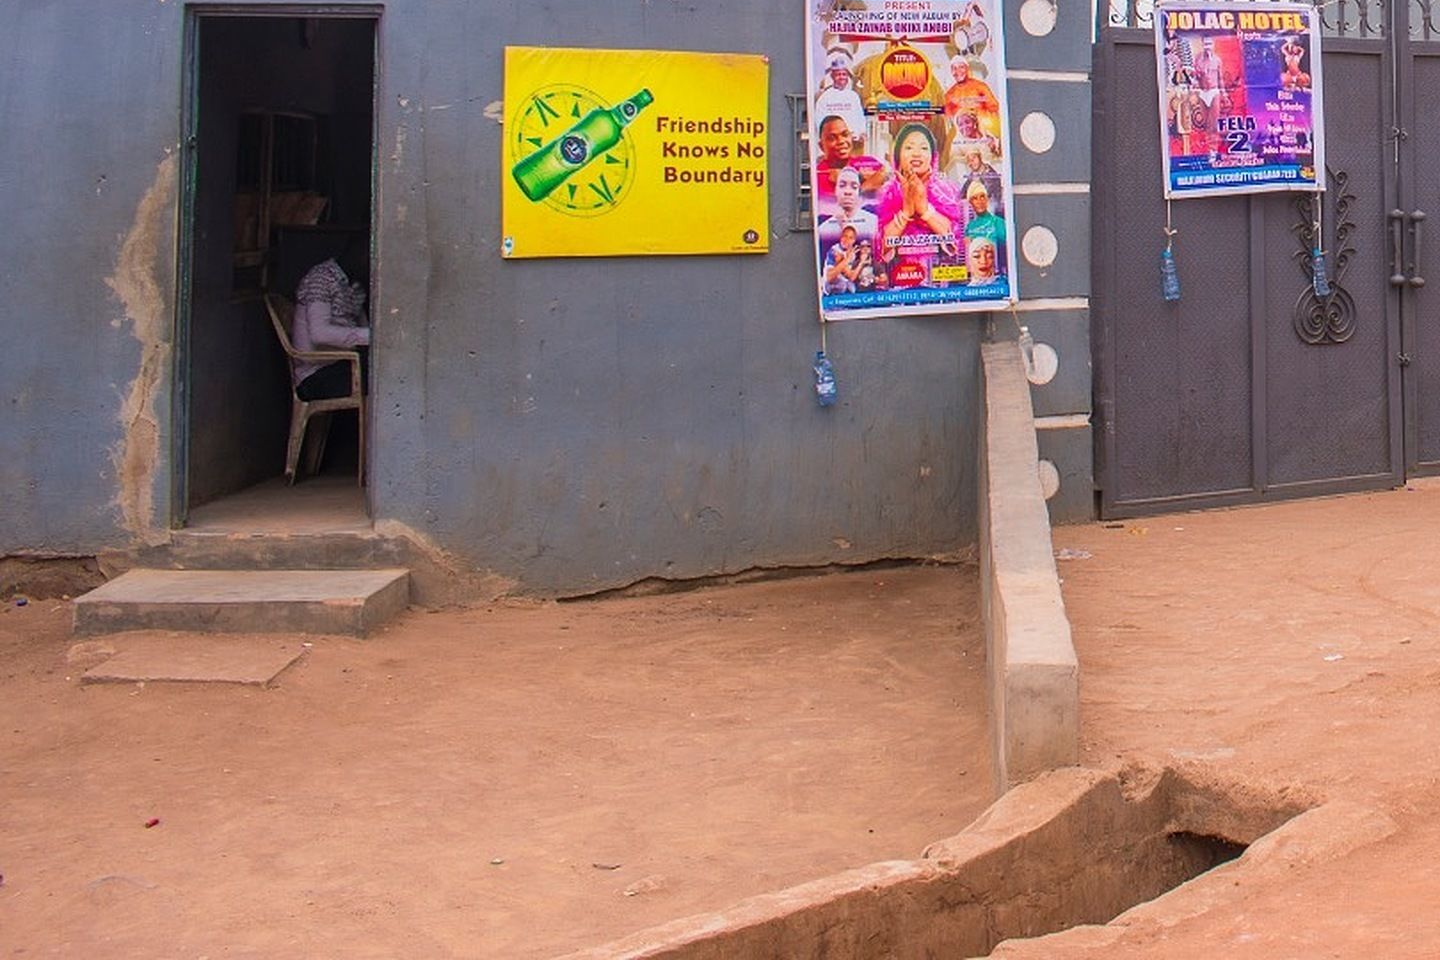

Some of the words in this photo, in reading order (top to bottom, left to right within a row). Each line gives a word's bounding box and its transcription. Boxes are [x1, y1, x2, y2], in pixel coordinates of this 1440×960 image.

[884, 2, 932, 10] PRESENT
[886, 12, 898, 20] OF
[1168, 12, 1235, 30] JOLAC
[1239, 12, 1306, 31] HOTEL
[656, 116, 765, 138] Friendship
[1217, 117, 1256, 131] FELA
[662, 141, 729, 159] Knows
[736, 141, 765, 159] No
[1227, 132, 1250, 154] 2
[663, 166, 765, 187] Boundary
